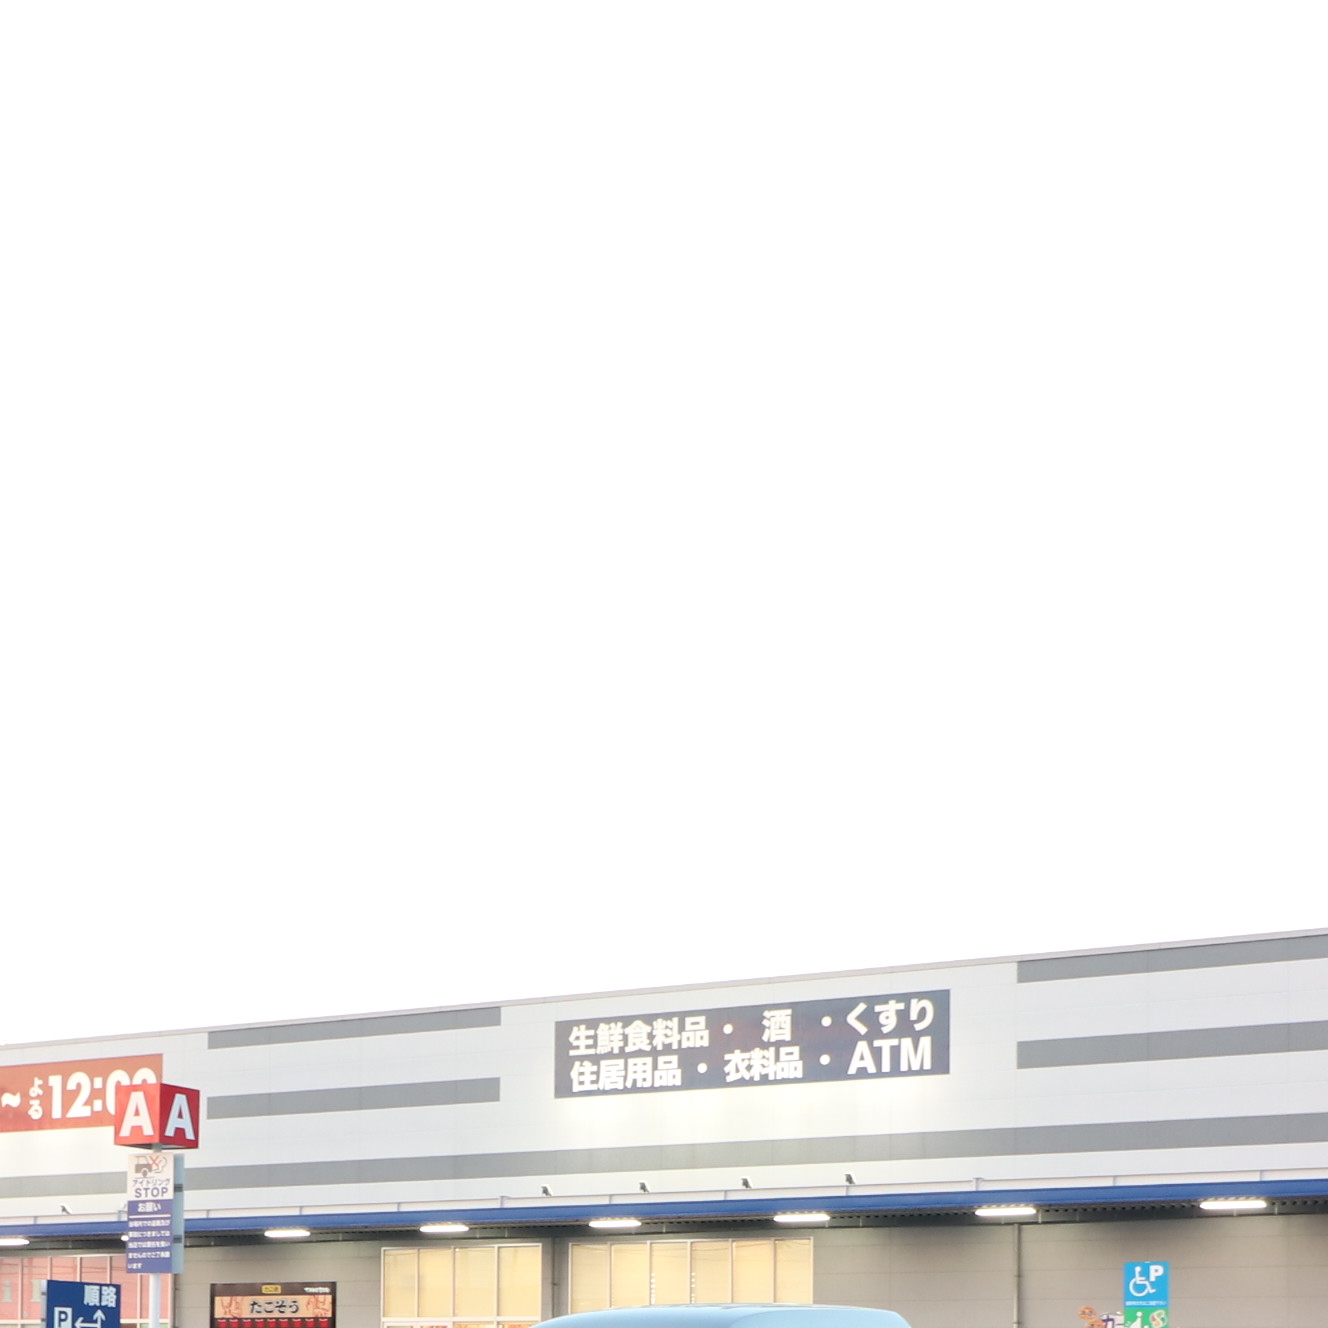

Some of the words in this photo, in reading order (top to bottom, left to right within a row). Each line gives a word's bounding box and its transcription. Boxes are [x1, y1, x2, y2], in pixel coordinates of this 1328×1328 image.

[28, 1077, 43, 1120] よる
[48, 1067, 157, 1119] 12:0
[118, 1091, 155, 1138] A
[164, 1094, 195, 1140] A
[134, 1187, 169, 1198] STOP
[1149, 1265, 1164, 1282] P
[83, 1285, 117, 1308] 順路
[250, 1300, 300, 1314] たこそう
[57, 1311, 69, 1328] P
